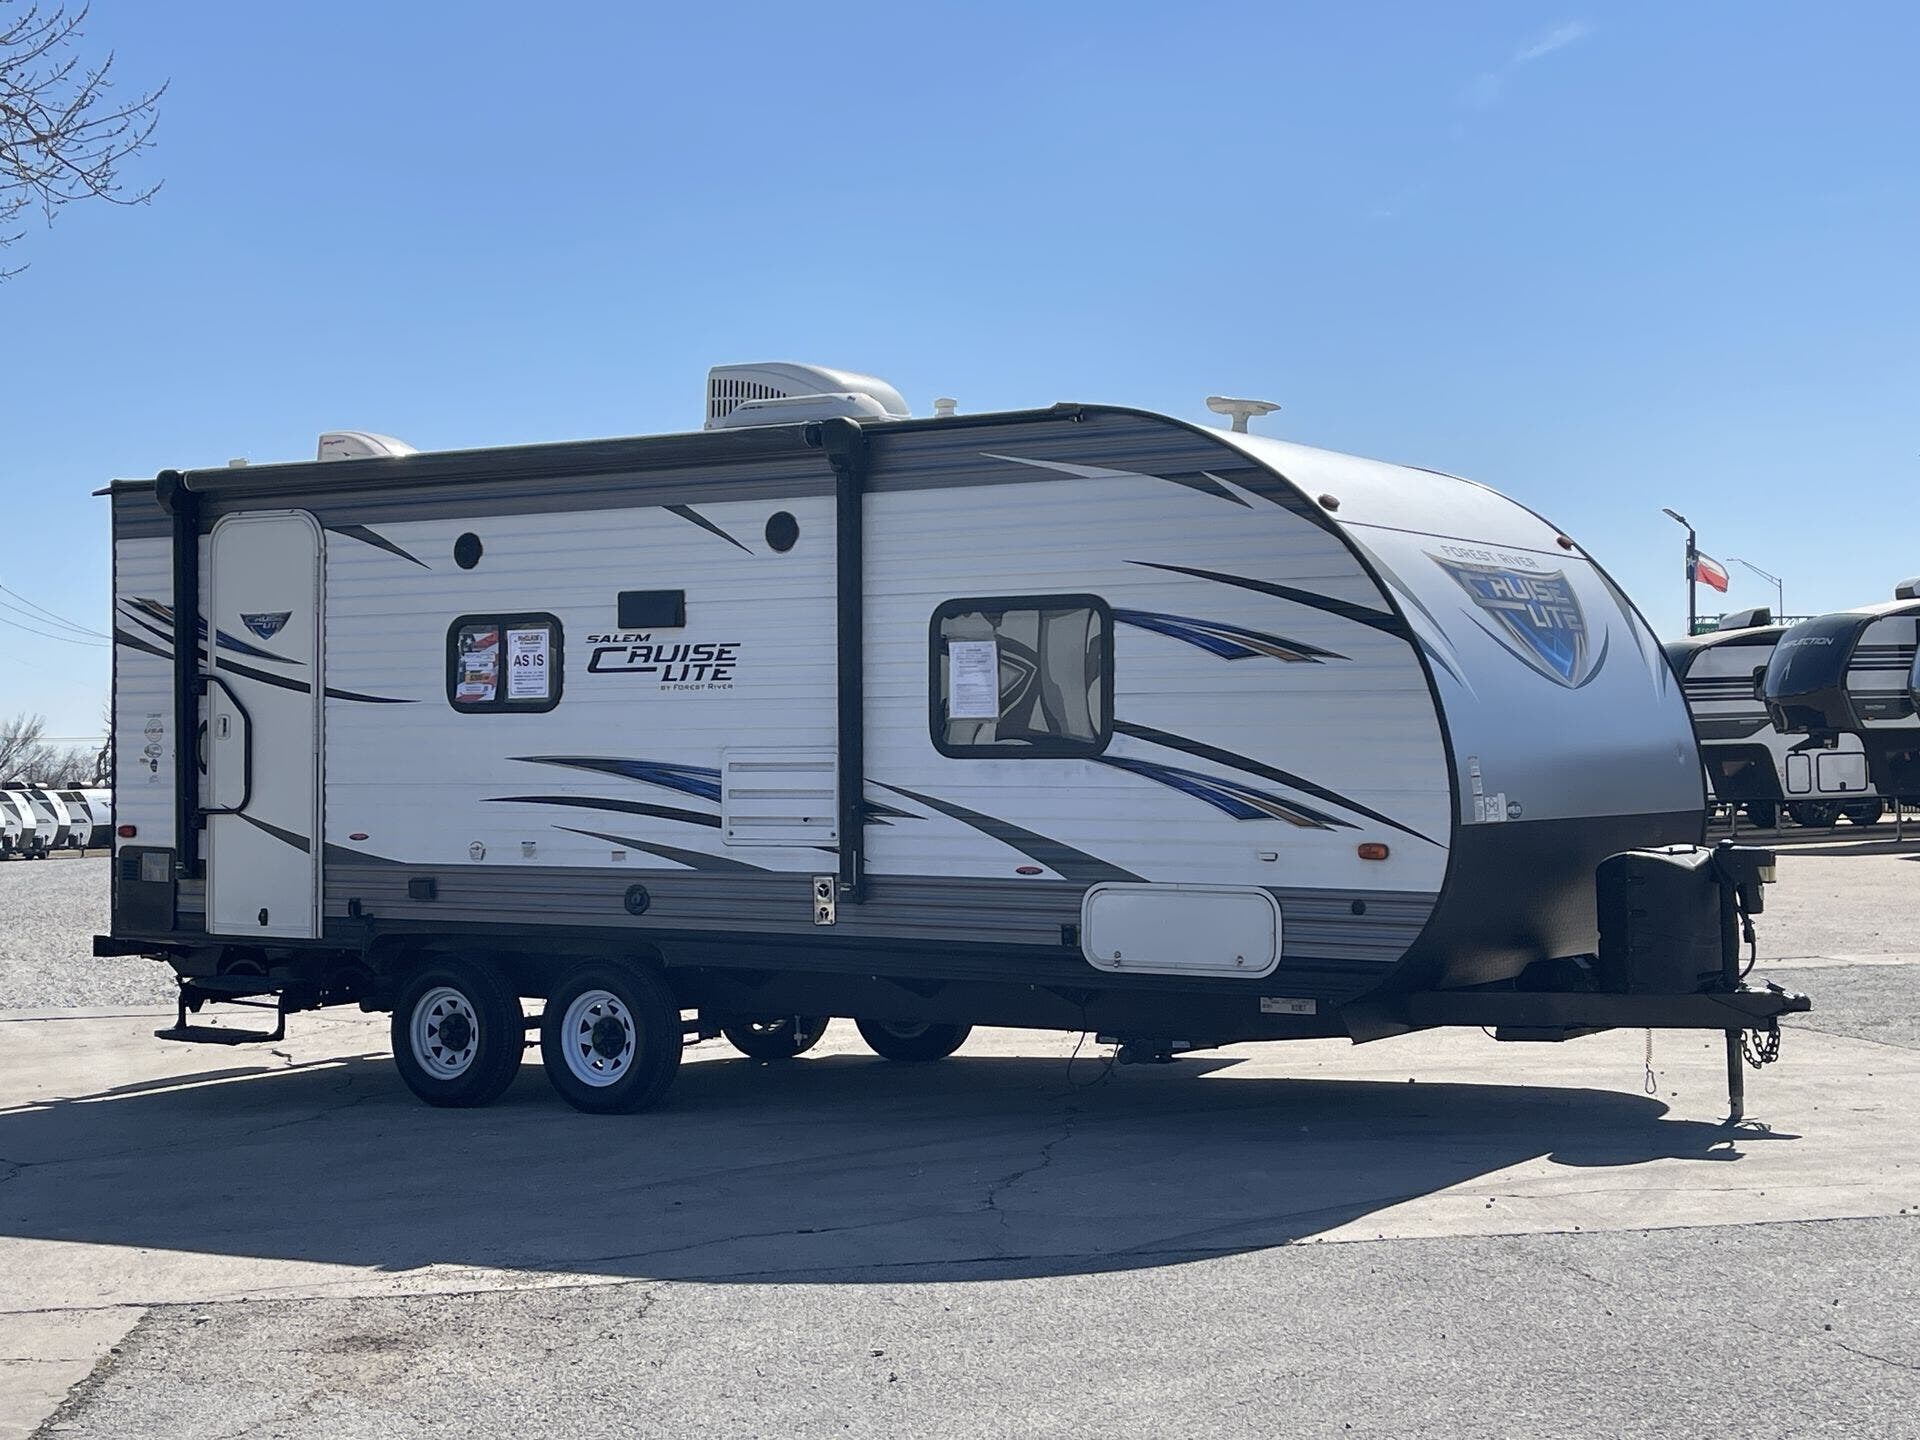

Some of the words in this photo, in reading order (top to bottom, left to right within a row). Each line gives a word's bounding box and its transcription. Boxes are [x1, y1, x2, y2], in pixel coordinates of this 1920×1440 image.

[1441, 545, 1496, 562] FOREST
[1500, 554, 1539, 568] RIVER
[1458, 572, 1570, 612] CRUISE
[1527, 602, 1582, 631] LITE
[586, 633, 652, 644] SALEM
[513, 654, 530, 667] AS
[532, 653, 545, 667] IS
[587, 643, 741, 674] CRUISE
[661, 663, 736, 682] LITE
[660, 683, 671, 691] BY
[673, 683, 705, 691] FOREST
